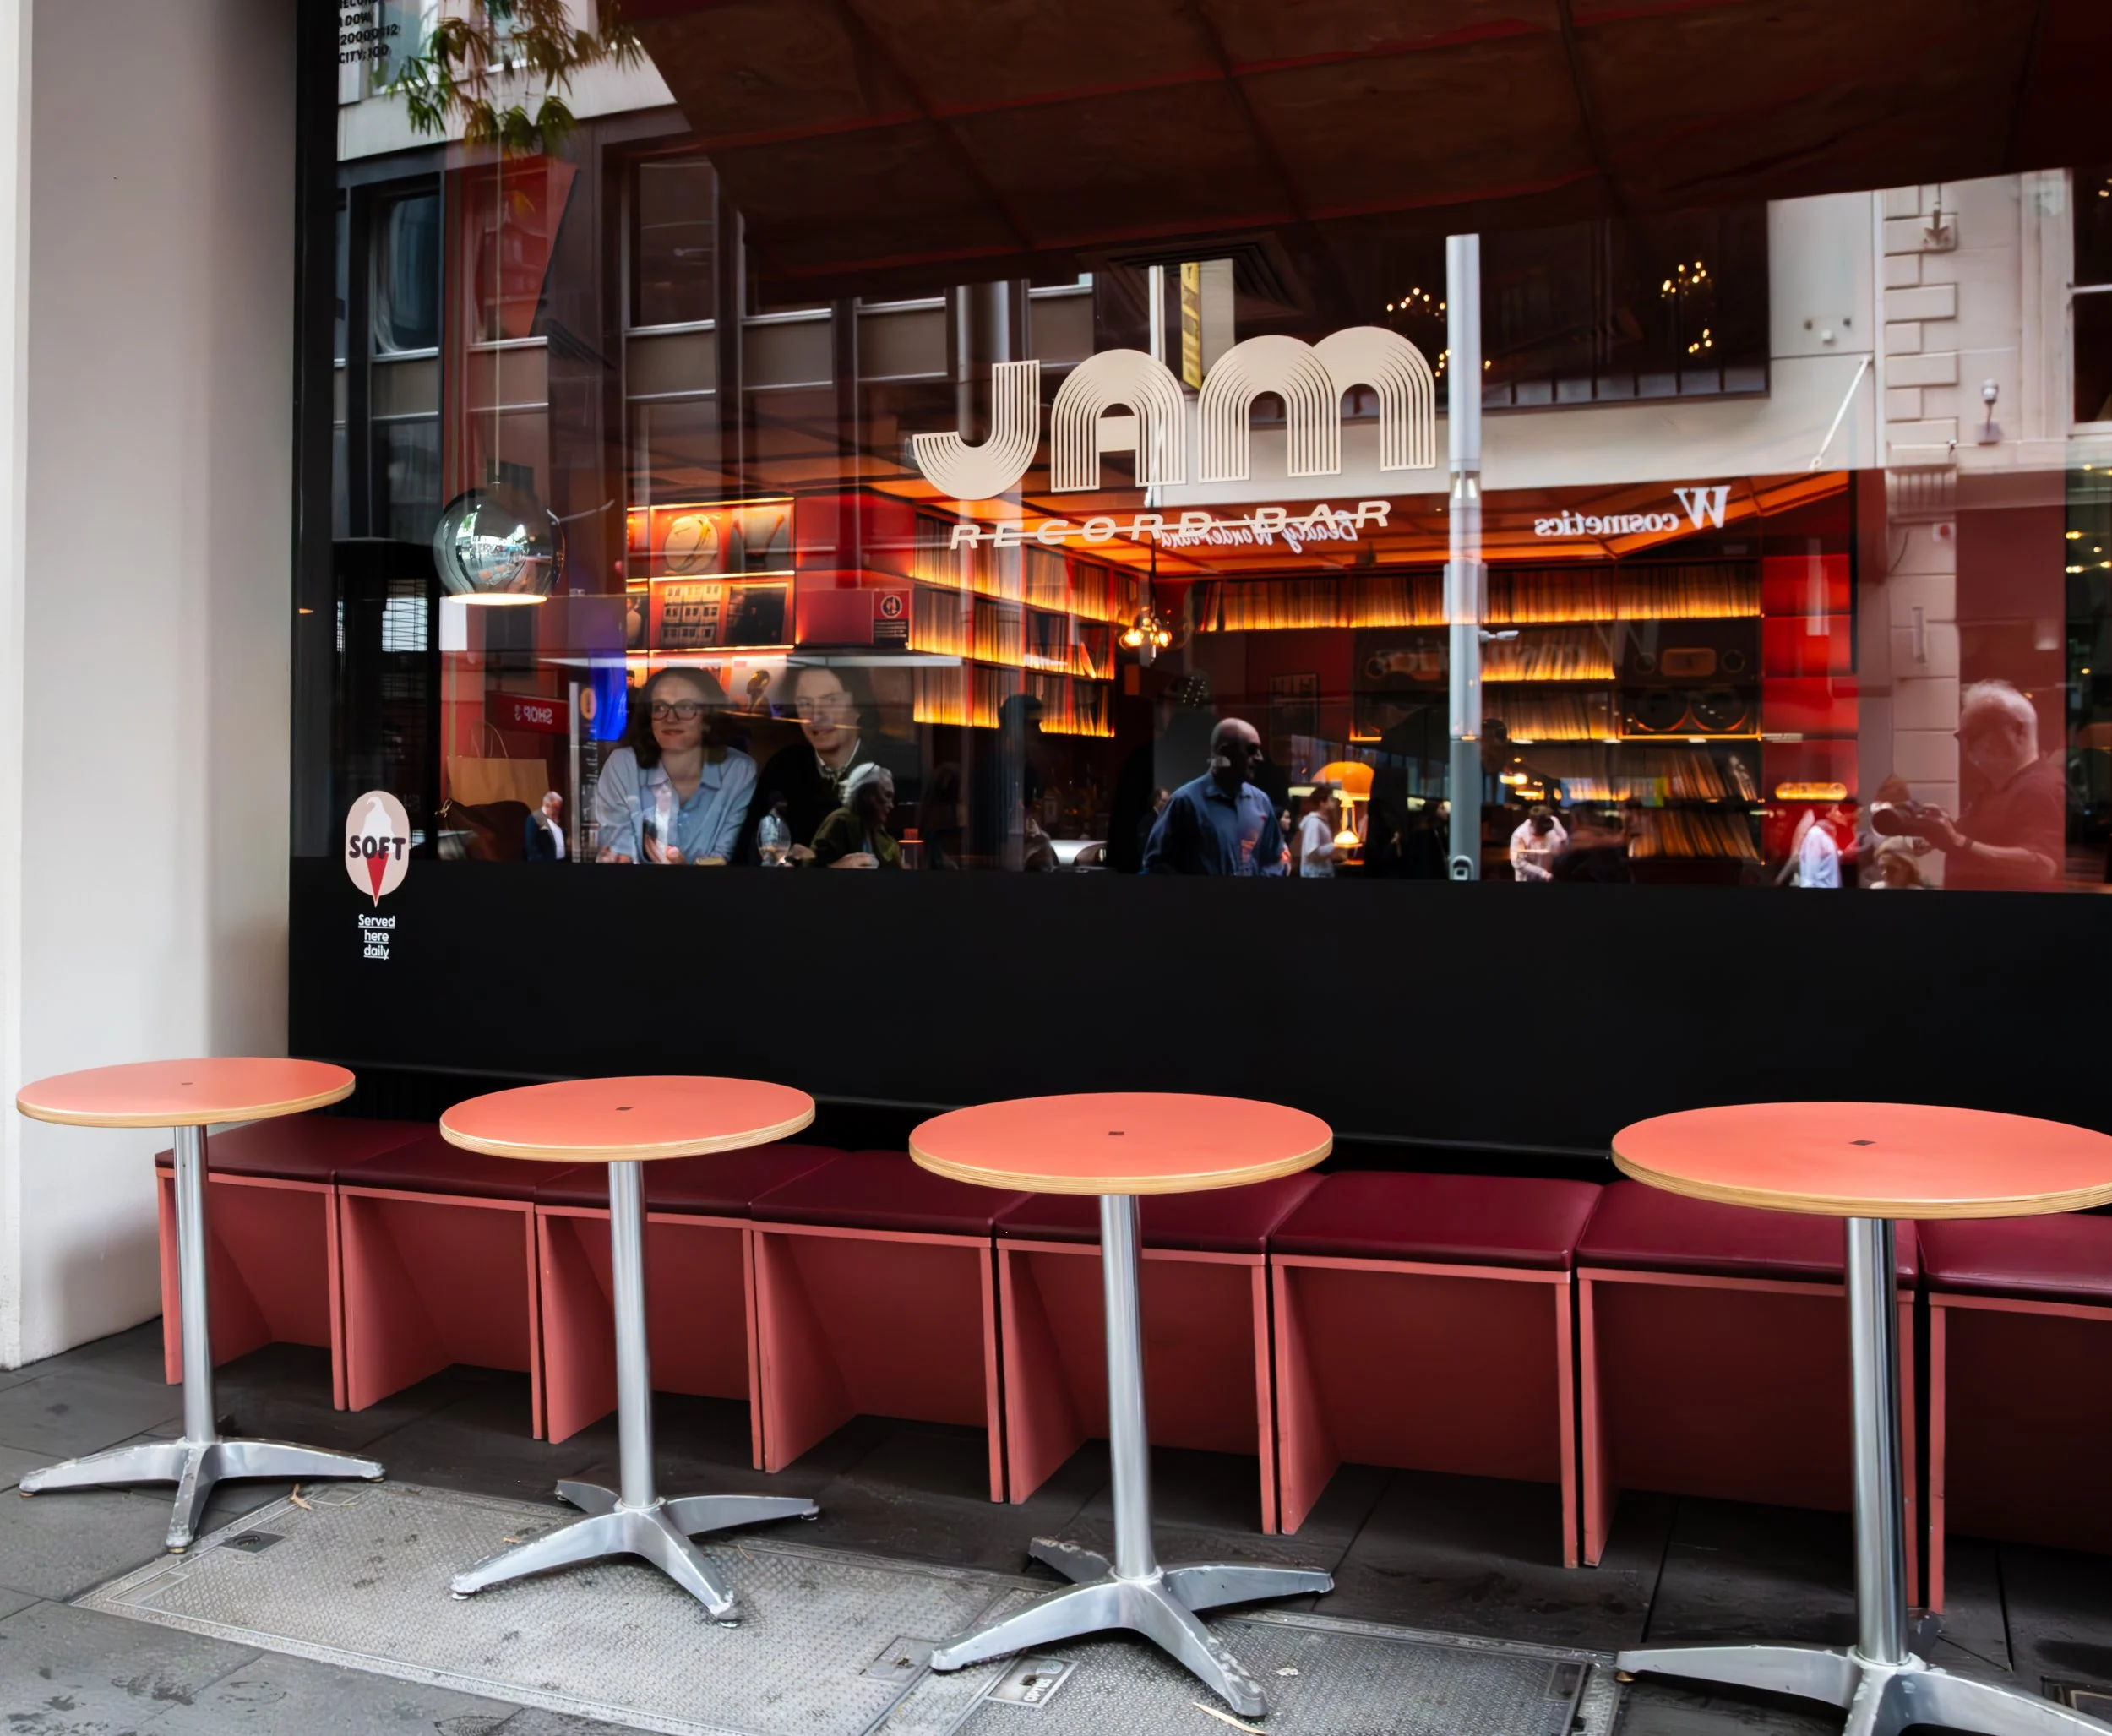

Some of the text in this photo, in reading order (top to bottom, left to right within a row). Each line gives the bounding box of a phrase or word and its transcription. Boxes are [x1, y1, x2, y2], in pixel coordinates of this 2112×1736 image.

[950, 500, 1392, 550] RECORD BAR
[348, 835, 406, 861] SOFT
[358, 914, 395, 928] Served
[364, 929, 389, 943] here
[363, 944, 389, 960] daily
